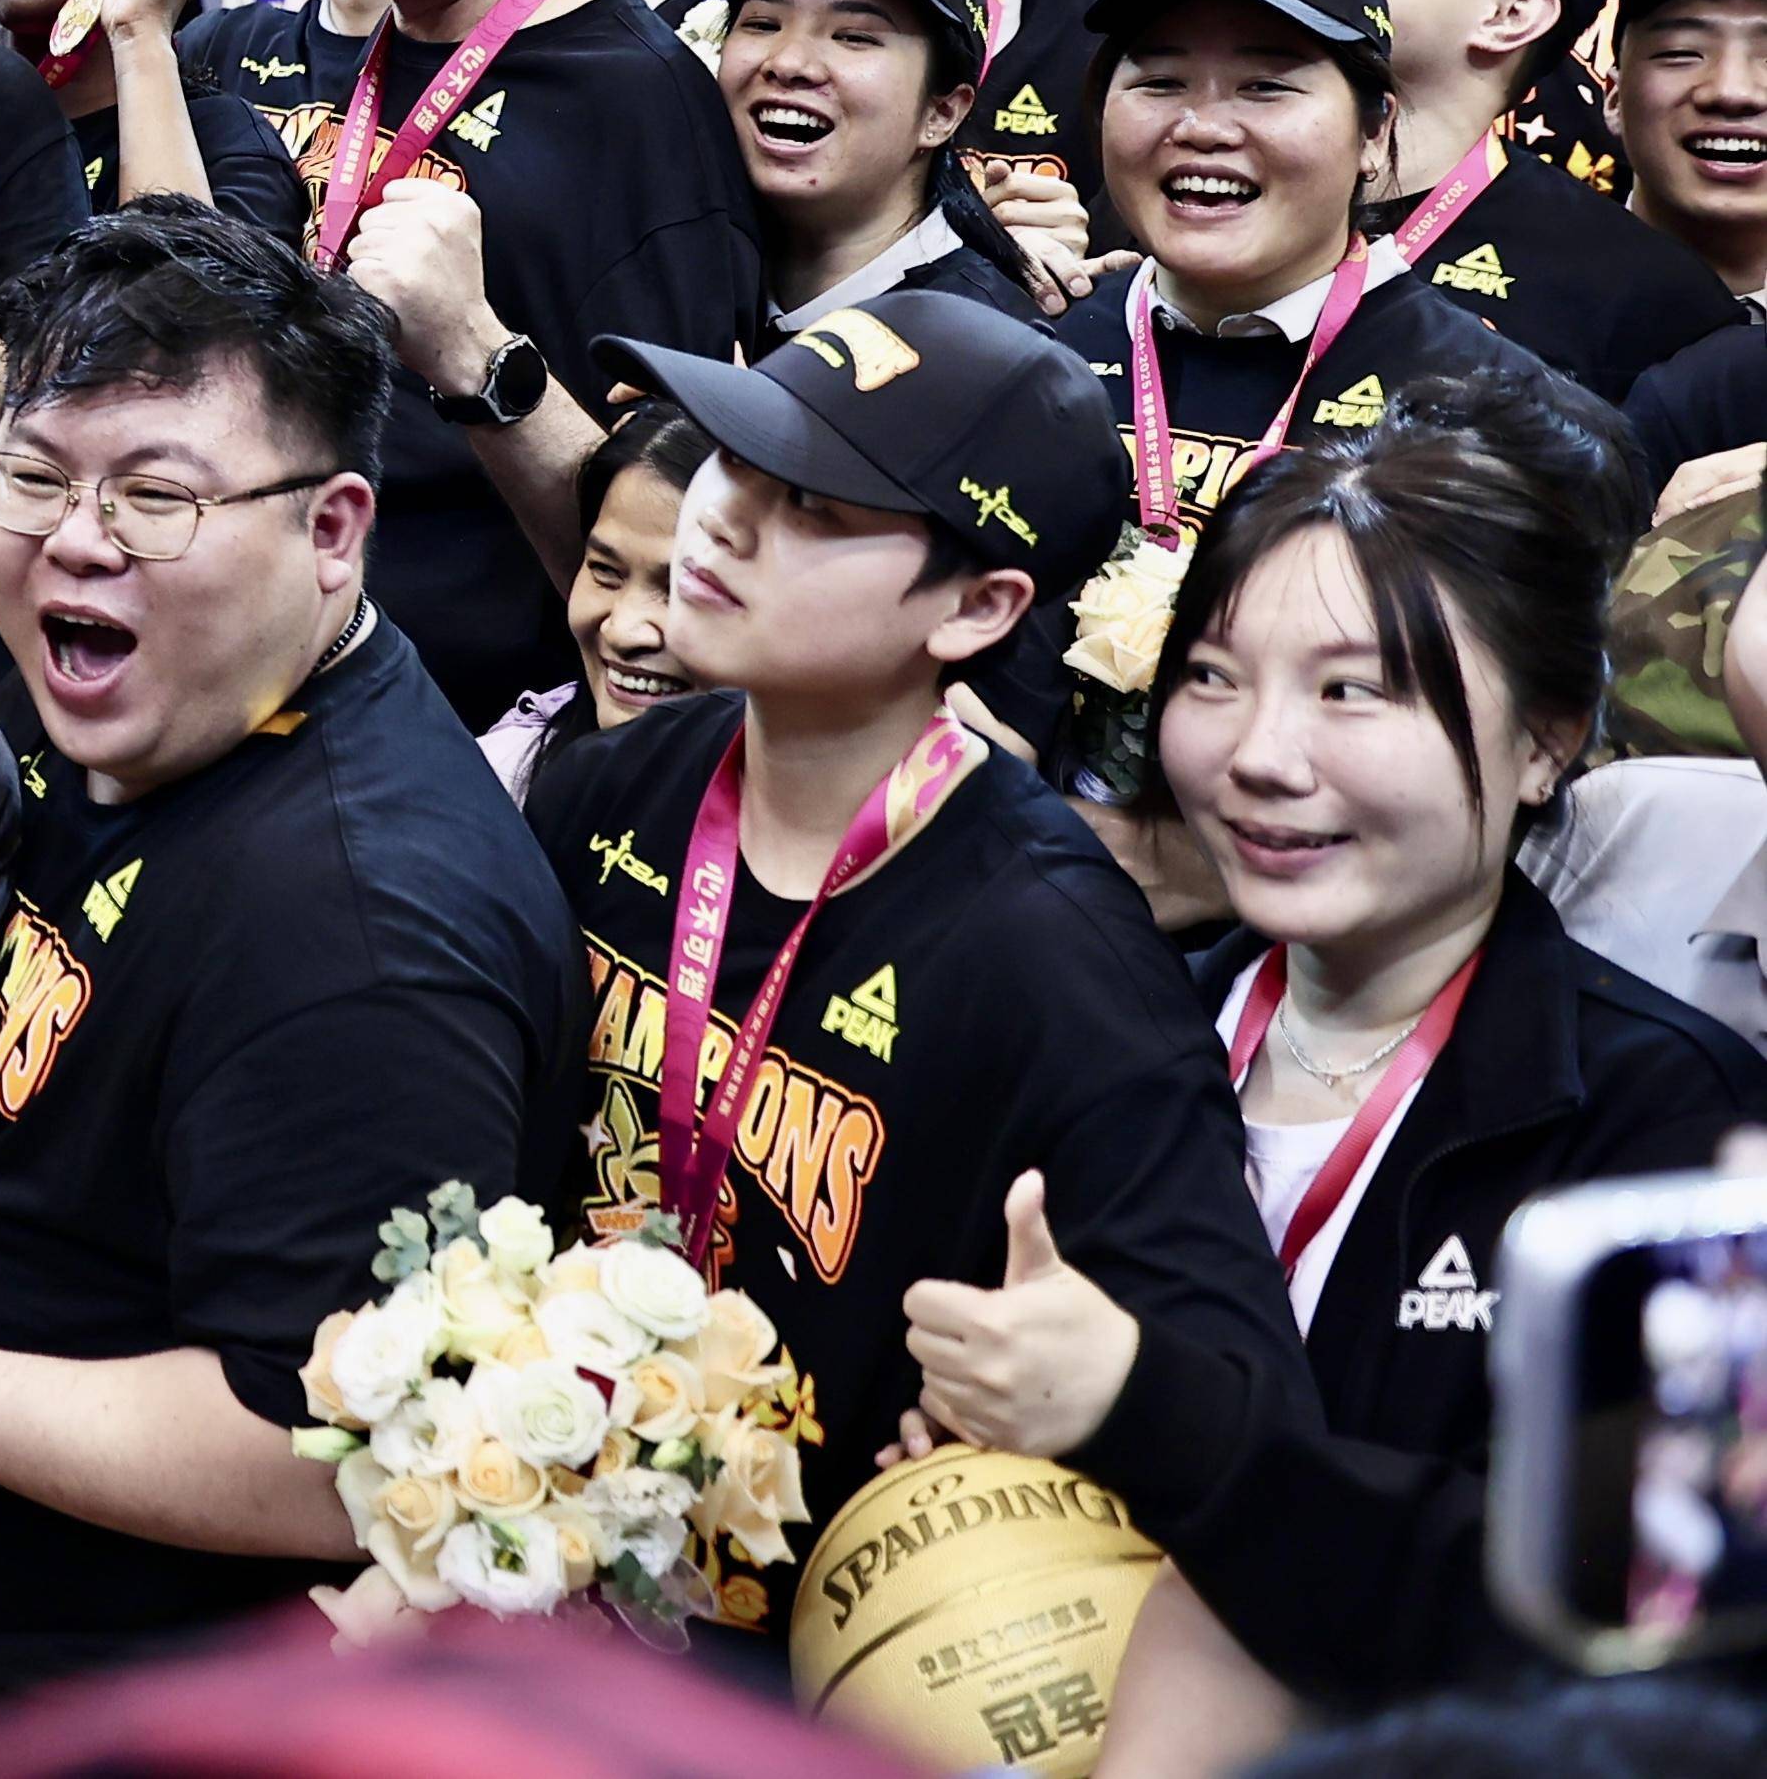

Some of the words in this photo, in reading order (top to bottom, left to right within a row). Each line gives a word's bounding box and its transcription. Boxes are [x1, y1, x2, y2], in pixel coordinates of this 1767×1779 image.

[995, 109, 1059, 135] PEAK
[1406, 178, 1470, 247] 2024-2025
[1431, 265, 1517, 301] PEAK
[677, 860, 725, 1004] 心不可挡
[821, 993, 900, 1064] PEAK
[1398, 1288, 1500, 1332] PEAK
[821, 1477, 1123, 1631] SPALDING
[980, 1672, 1106, 1765] 冠军
